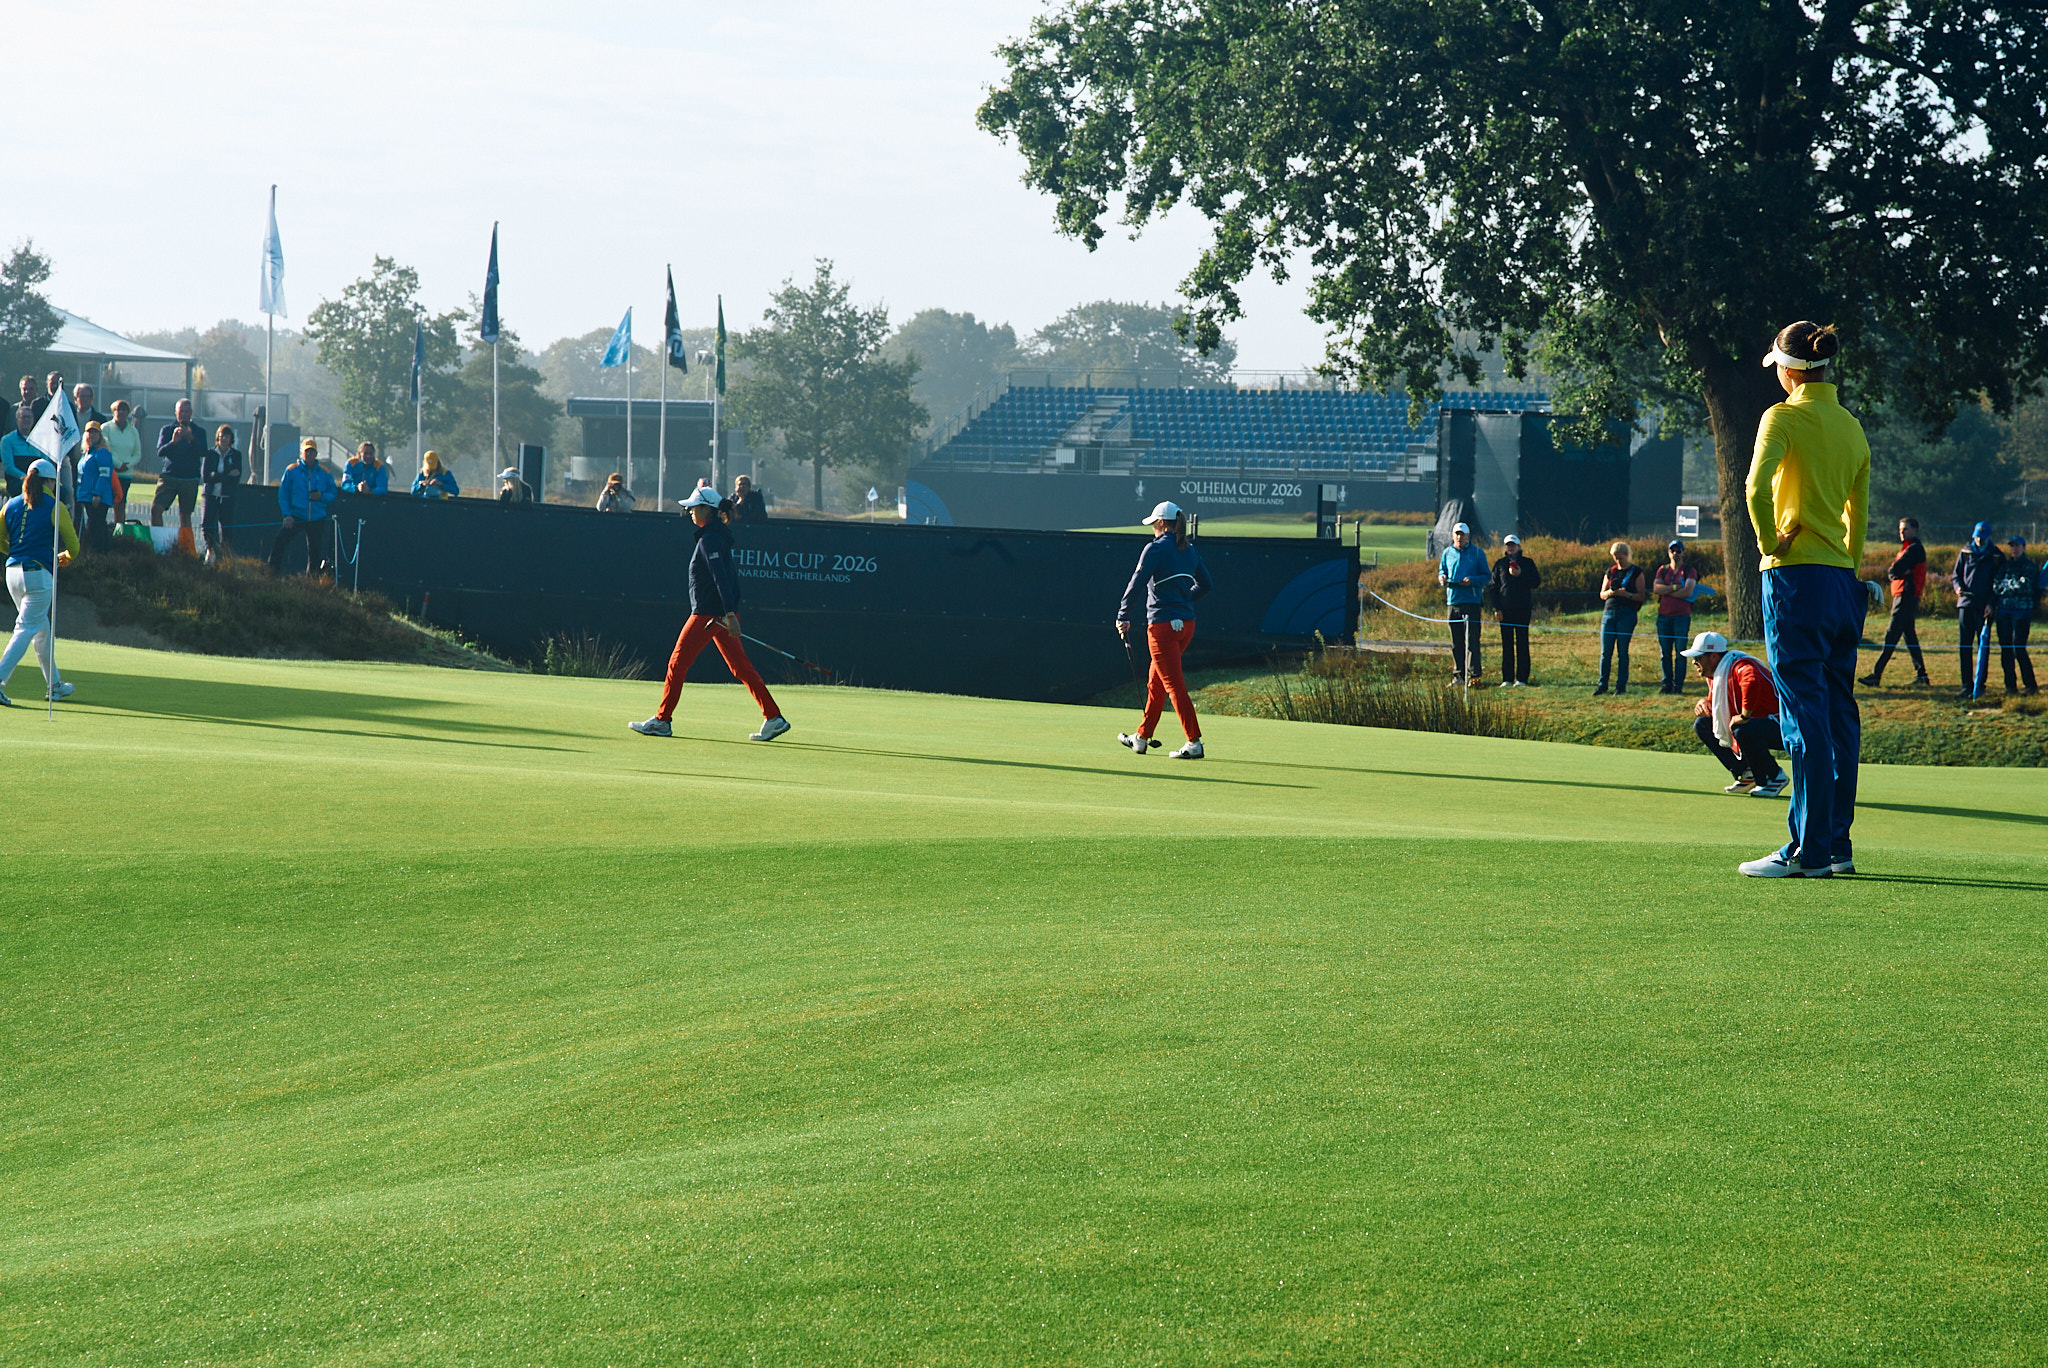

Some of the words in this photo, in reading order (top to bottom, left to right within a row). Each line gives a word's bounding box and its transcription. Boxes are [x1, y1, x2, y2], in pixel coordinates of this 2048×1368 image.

[1179, 480, 1237, 495] SOLHEIM
[1238, 482, 1266, 496] CUP
[1271, 483, 1302, 497] 2026
[1239, 497, 1284, 505] NETHERLANDS
[730, 548, 780, 567] HEIM
[784, 552, 825, 569] CUP
[832, 554, 877, 573] 2026
[736, 568, 781, 580] NARDUS,
[782, 571, 851, 583] NETHERLANDS
